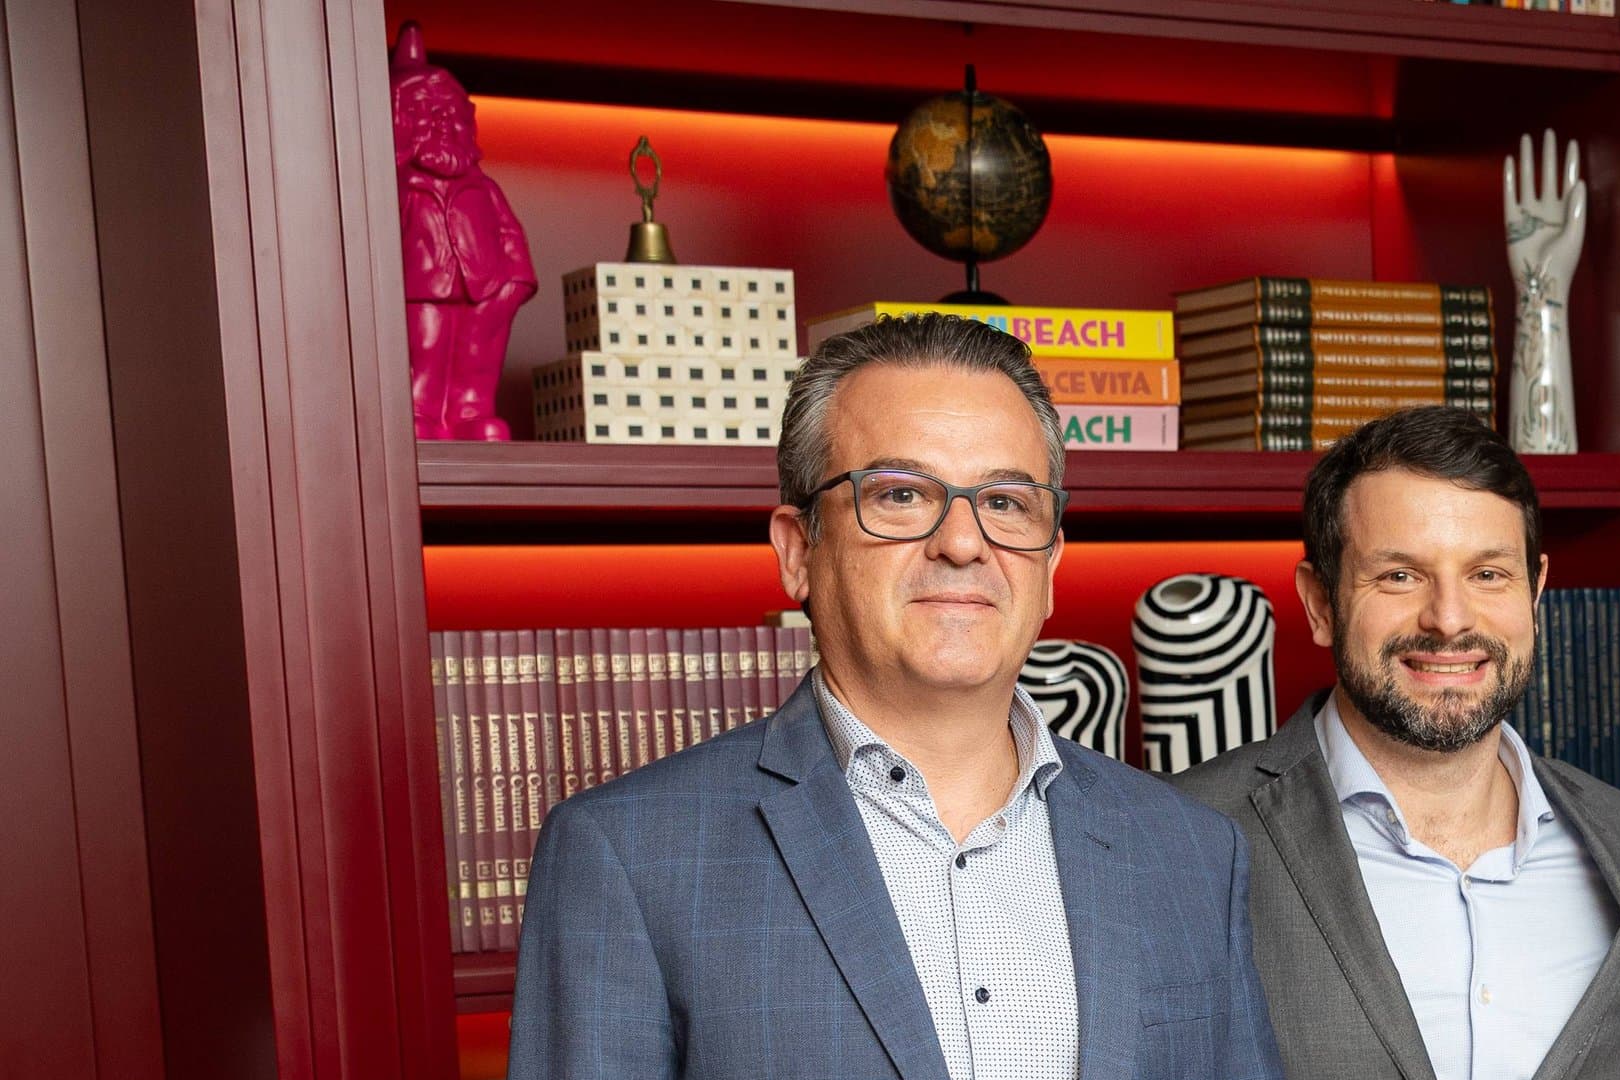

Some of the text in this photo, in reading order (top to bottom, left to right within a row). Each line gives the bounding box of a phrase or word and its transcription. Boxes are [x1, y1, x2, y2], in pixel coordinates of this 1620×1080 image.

[1012, 317, 1126, 348] BEACH
[1089, 370, 1152, 396] VITA
[1063, 415, 1132, 443] ACH
[470, 713, 483, 774] Larousse
[561, 711, 576, 772] Larousse
[597, 709, 612, 769] Larousse
[618, 709, 632, 769] Larousse
[488, 712, 507, 832] Larousse Cultural
[507, 712, 527, 832] Larousse Cultural
[523, 711, 542, 830] Larousse Cultural
